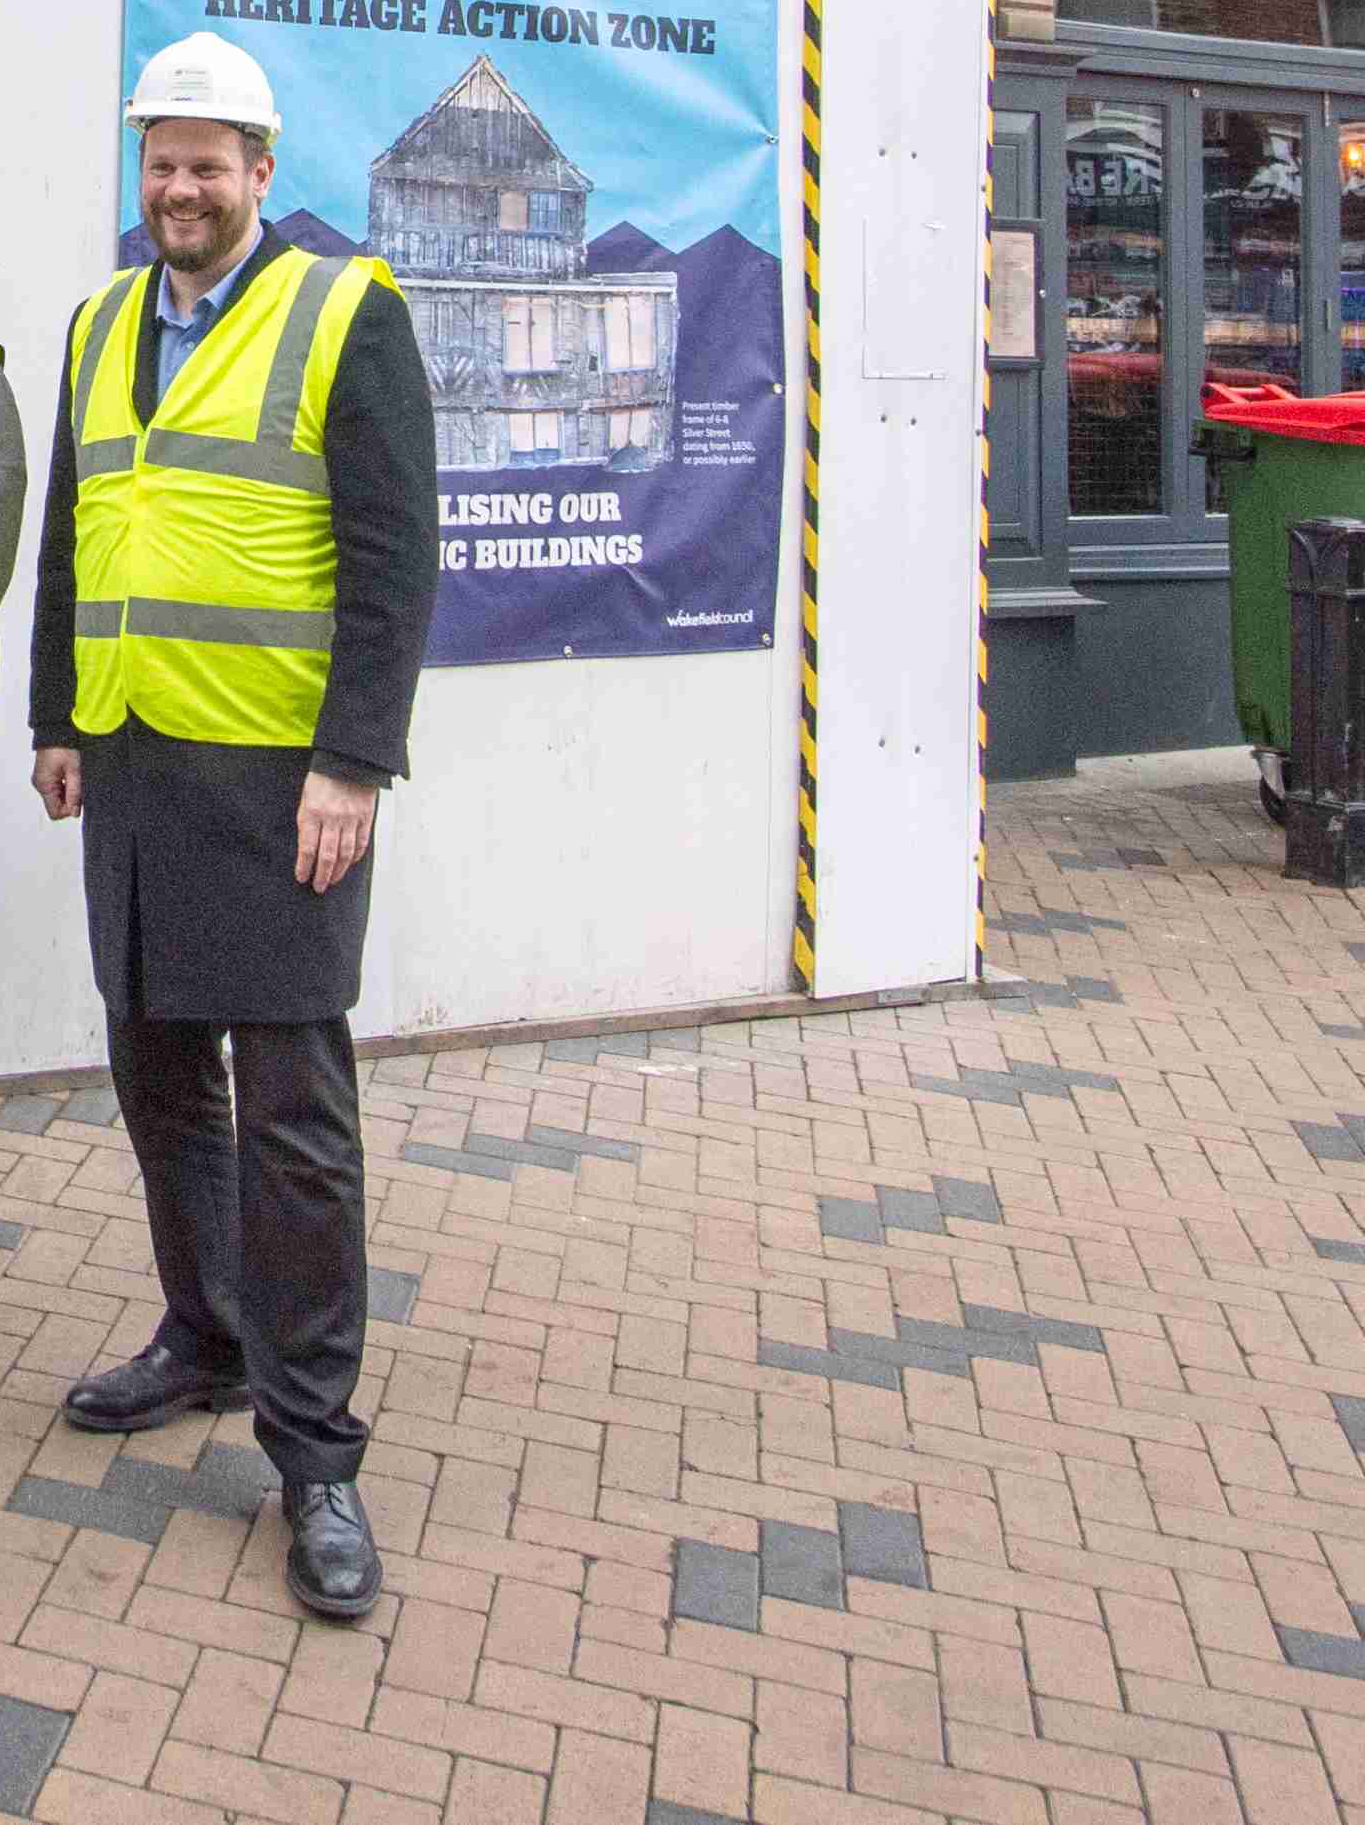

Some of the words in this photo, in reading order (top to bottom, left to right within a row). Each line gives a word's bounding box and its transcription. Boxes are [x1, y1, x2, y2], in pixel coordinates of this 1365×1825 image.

[606, 13, 716, 55] ZONE
[437, 492, 554, 526] LISING
[559, 491, 622, 524] OUR
[474, 534, 644, 570] BUILDINGS
